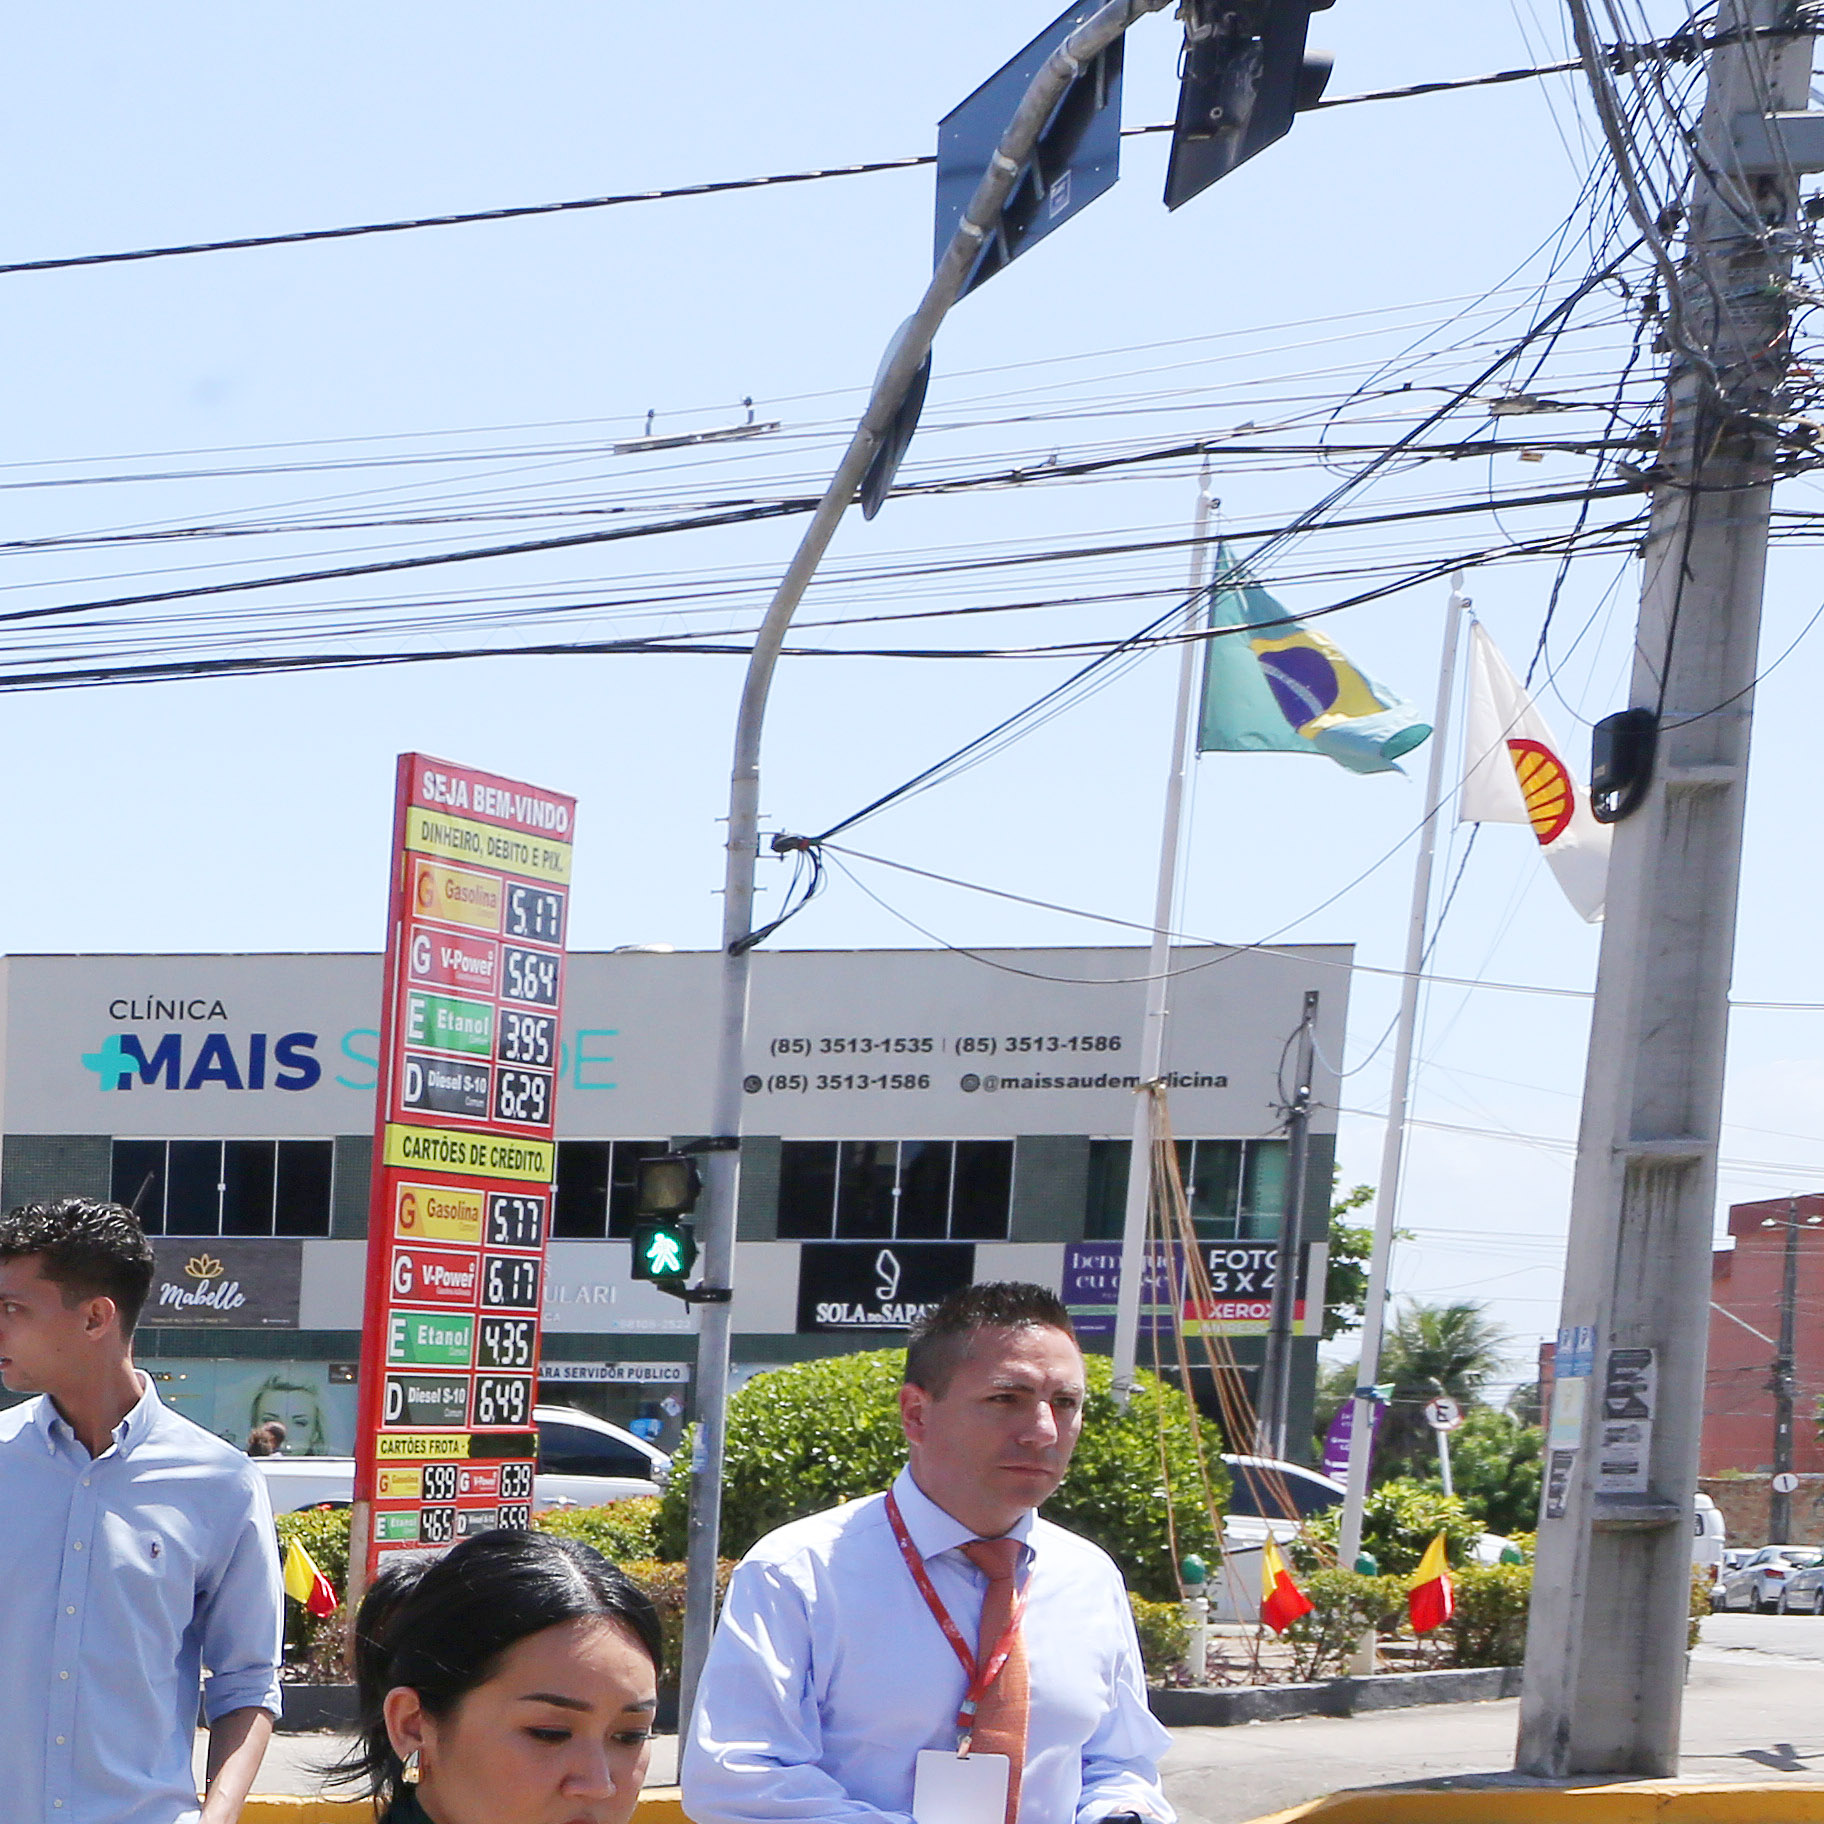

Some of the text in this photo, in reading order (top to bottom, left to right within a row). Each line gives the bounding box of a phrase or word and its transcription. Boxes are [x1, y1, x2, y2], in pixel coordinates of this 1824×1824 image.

[422, 770, 569, 833] SEJA BEM-VINDO
[421, 820, 483, 858] DINHEIRO,
[531, 849, 540, 866] E
[418, 870, 497, 908] G Gasolina
[413, 934, 493, 976] G V-Power
[108, 995, 228, 1020] CLÍNICA
[408, 998, 489, 1039] E Etanol
[770, 1036, 1122, 1057] (85) 3513-1535 (85) 3513-1586
[116, 1032, 322, 1091] MAIS
[405, 1062, 487, 1102] D Diesel S-10
[767, 1074, 930, 1093] (85) 3513-1586
[982, 1072, 1228, 1092] @maissaudemdicina
[402, 1135, 545, 1173] CARTÕES DE CRÉDITO.
[399, 1192, 479, 1229] G Gasolina
[1209, 1250, 1279, 1270] FOTO
[394, 1255, 474, 1294] G V-Power
[1211, 1272, 1228, 1292] 3
[1235, 1272, 1254, 1292] X
[159, 1279, 246, 1310] Mabelle
[816, 1303, 865, 1322] SOLA
[881, 1303, 939, 1323] SAPA
[1208, 1303, 1273, 1319] XEROX
[389, 1318, 469, 1357] E Etanol
[564, 1367, 624, 1378] SERVIDOR
[385, 1382, 466, 1420] D Diesel S-10
[380, 1436, 459, 1454] CARTÕES FROTA
[379, 1475, 389, 1492] G
[460, 1472, 470, 1492] G
[377, 1517, 386, 1537] E
[458, 1516, 467, 1534] D
